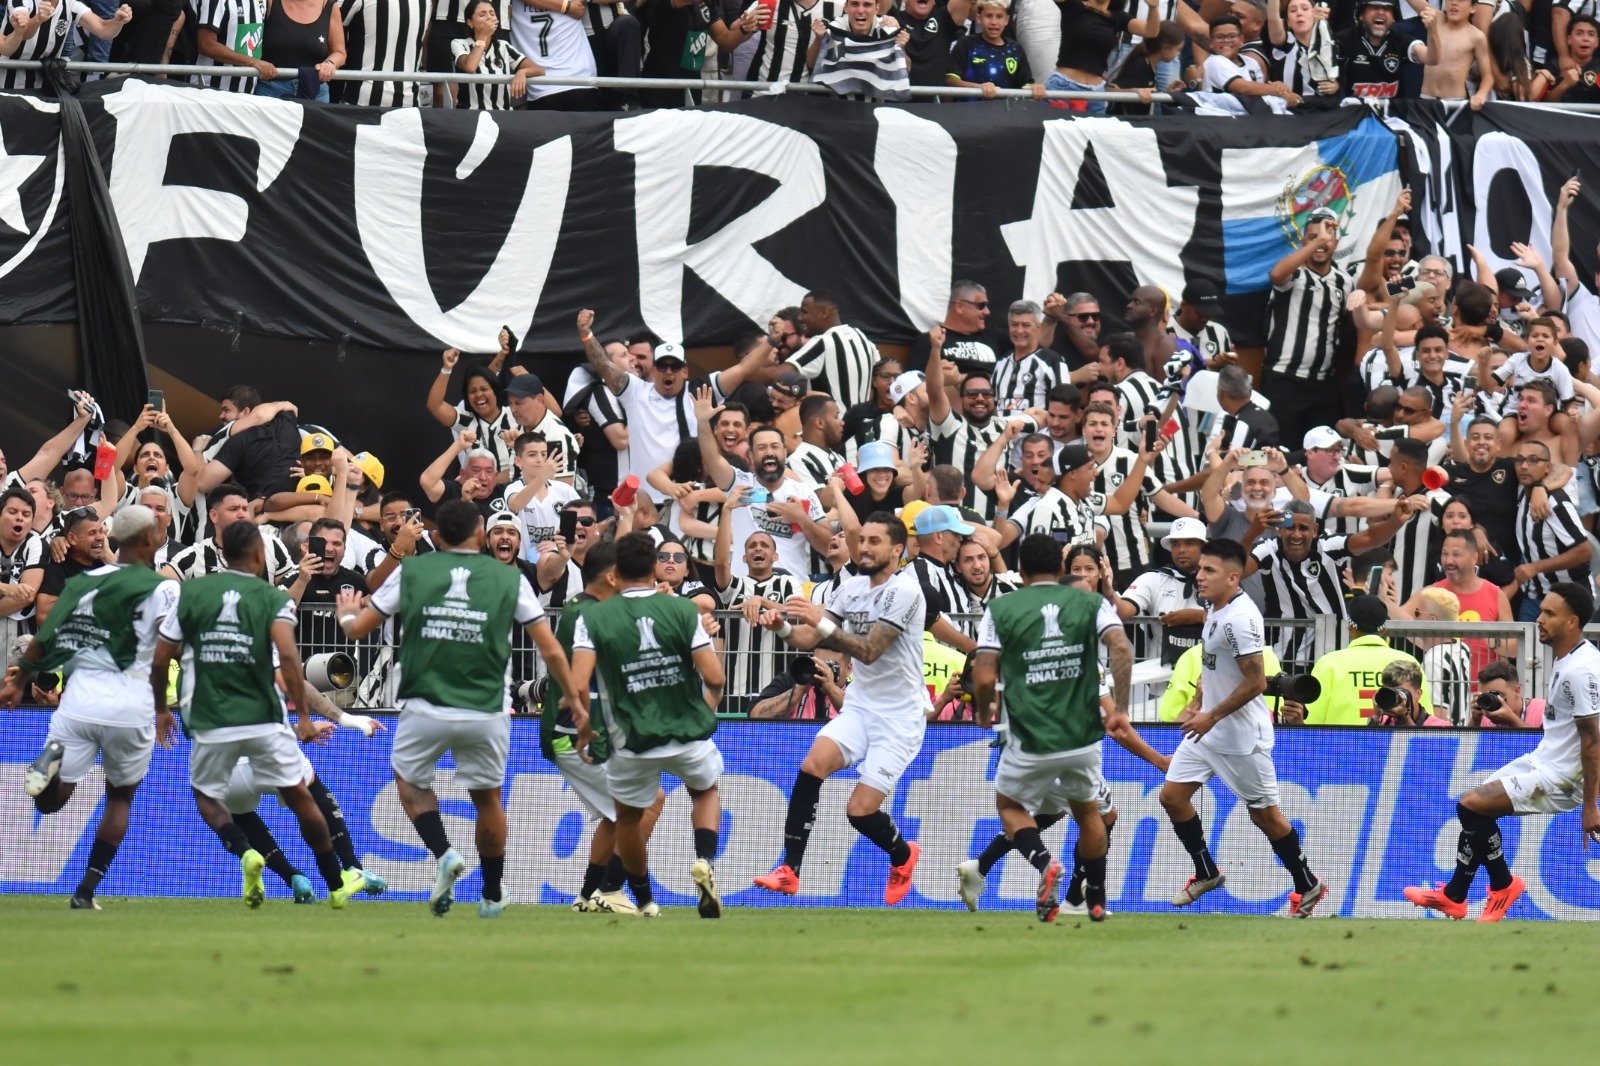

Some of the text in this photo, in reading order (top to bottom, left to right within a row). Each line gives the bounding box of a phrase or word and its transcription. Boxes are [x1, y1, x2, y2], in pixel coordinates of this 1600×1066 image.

[531, 14, 555, 57] 7
[102, 78, 1199, 352] FÚRIA
[422, 606, 488, 621] LIBERTADORES
[426, 619, 457, 630] BUENOS
[200, 631, 254, 646] LIBERTADORES
[421, 627, 484, 643] FINAL 2024
[1023, 644, 1085, 660] LIBERTADORES
[621, 654, 683, 673] LIBERTADORES
[1028, 660, 1060, 672] BUENOS
[627, 674, 685, 693] FINAL 2024
[1025, 671, 1059, 685] FINAL
